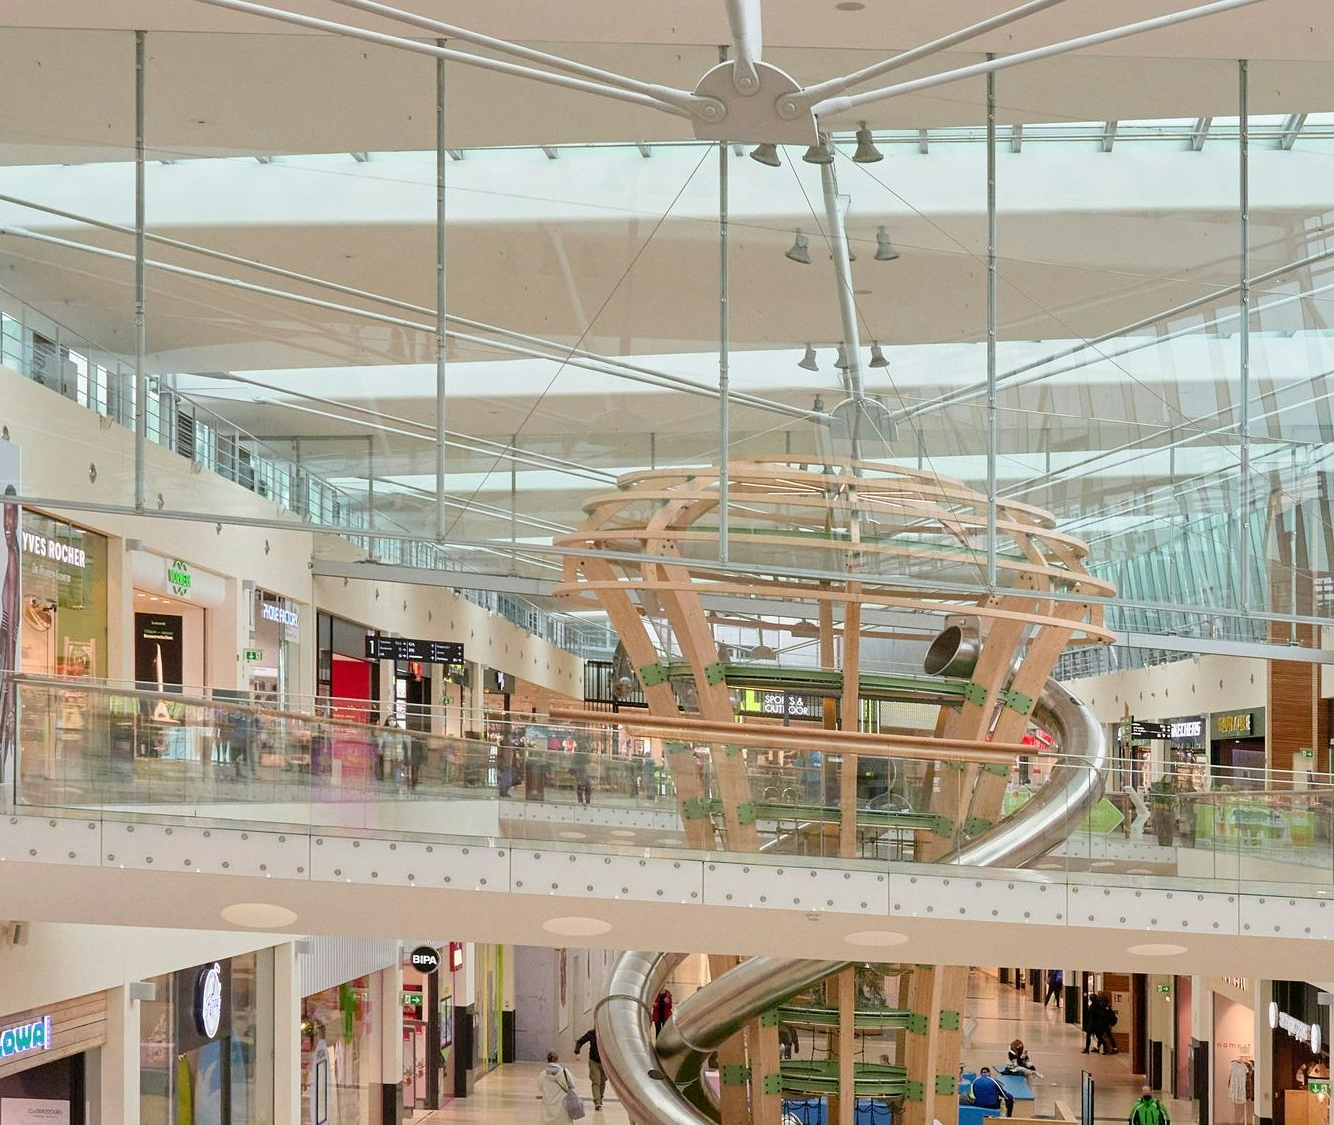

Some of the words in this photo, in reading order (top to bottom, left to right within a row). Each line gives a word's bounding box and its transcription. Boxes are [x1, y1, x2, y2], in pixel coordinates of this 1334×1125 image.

[22, 531, 47, 557] YVES
[48, 540, 86, 568] ROCHER
[369, 640, 375, 655] 1
[764, 704, 809, 715] OUTOOR
[412, 954, 437, 965] BIPA
